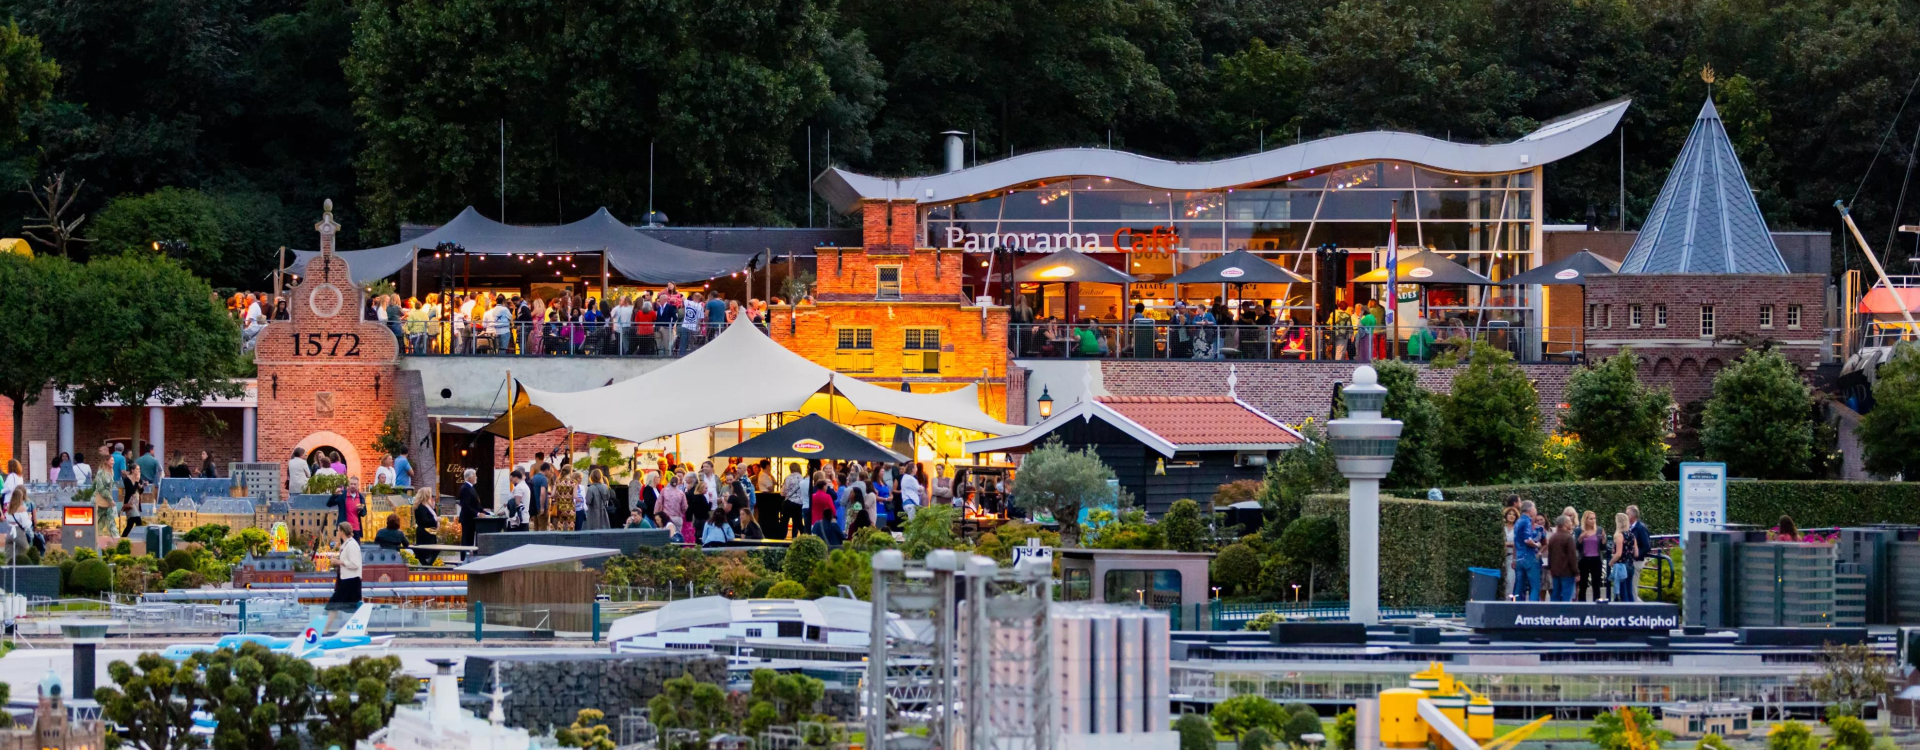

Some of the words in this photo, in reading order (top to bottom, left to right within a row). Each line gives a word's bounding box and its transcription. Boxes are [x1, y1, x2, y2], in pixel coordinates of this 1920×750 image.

[945, 227, 1100, 253] Panorama
[1112, 225, 1180, 253] Café
[291, 332, 360, 356] 1572
[1514, 614, 1581, 626] Amsterdam
[1583, 615, 1626, 628] Airport
[1628, 615, 1677, 629] Schiphol
